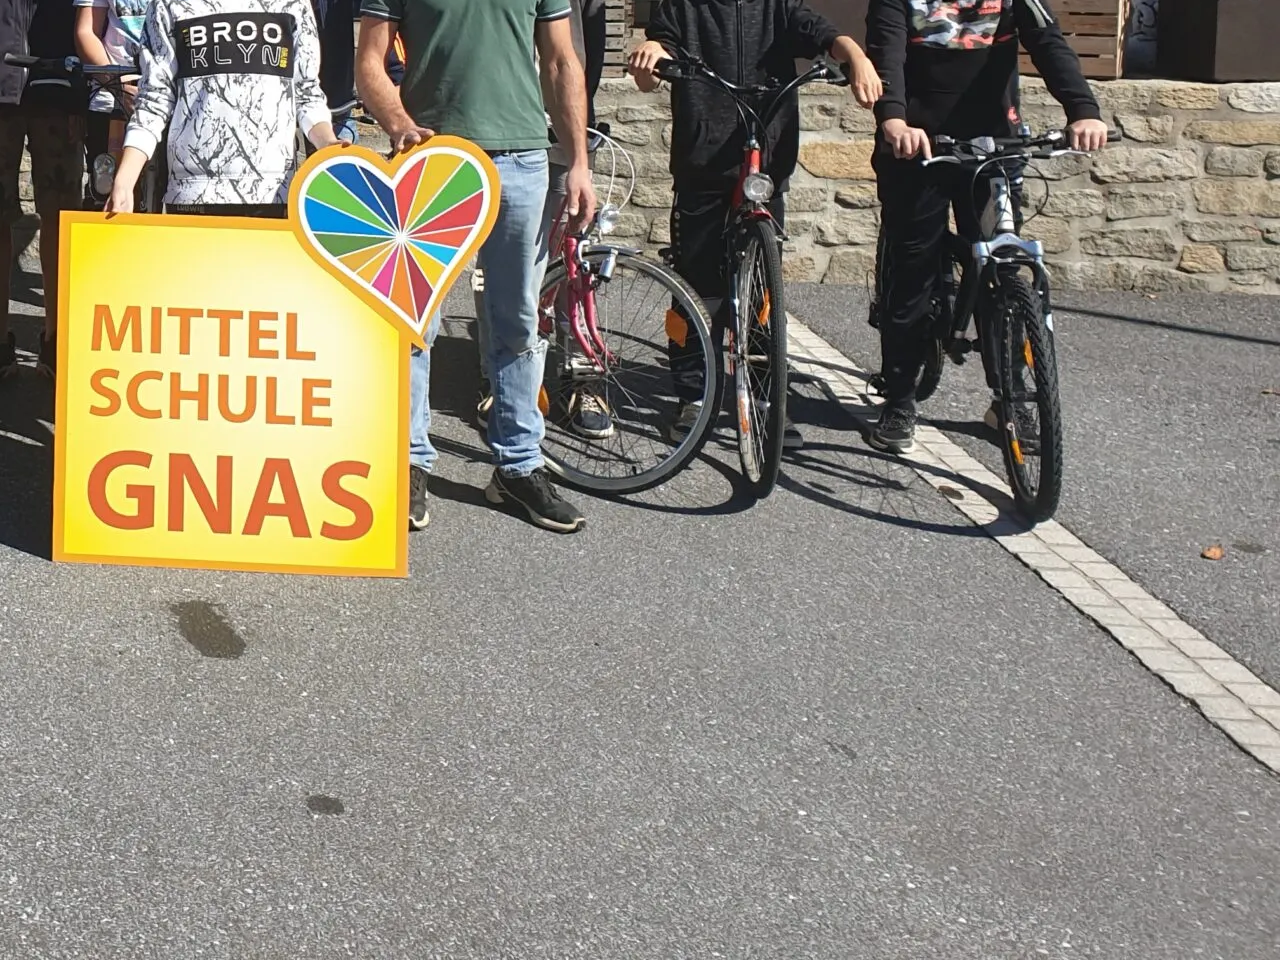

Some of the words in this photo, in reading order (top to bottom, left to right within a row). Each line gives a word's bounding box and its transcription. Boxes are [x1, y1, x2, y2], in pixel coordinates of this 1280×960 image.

[189, 20, 282, 47] BROO
[190, 43, 282, 69] KLYN
[91, 304, 316, 361] MITTEL
[89, 369, 332, 427] SCHULE
[87, 450, 374, 541] GNAS
